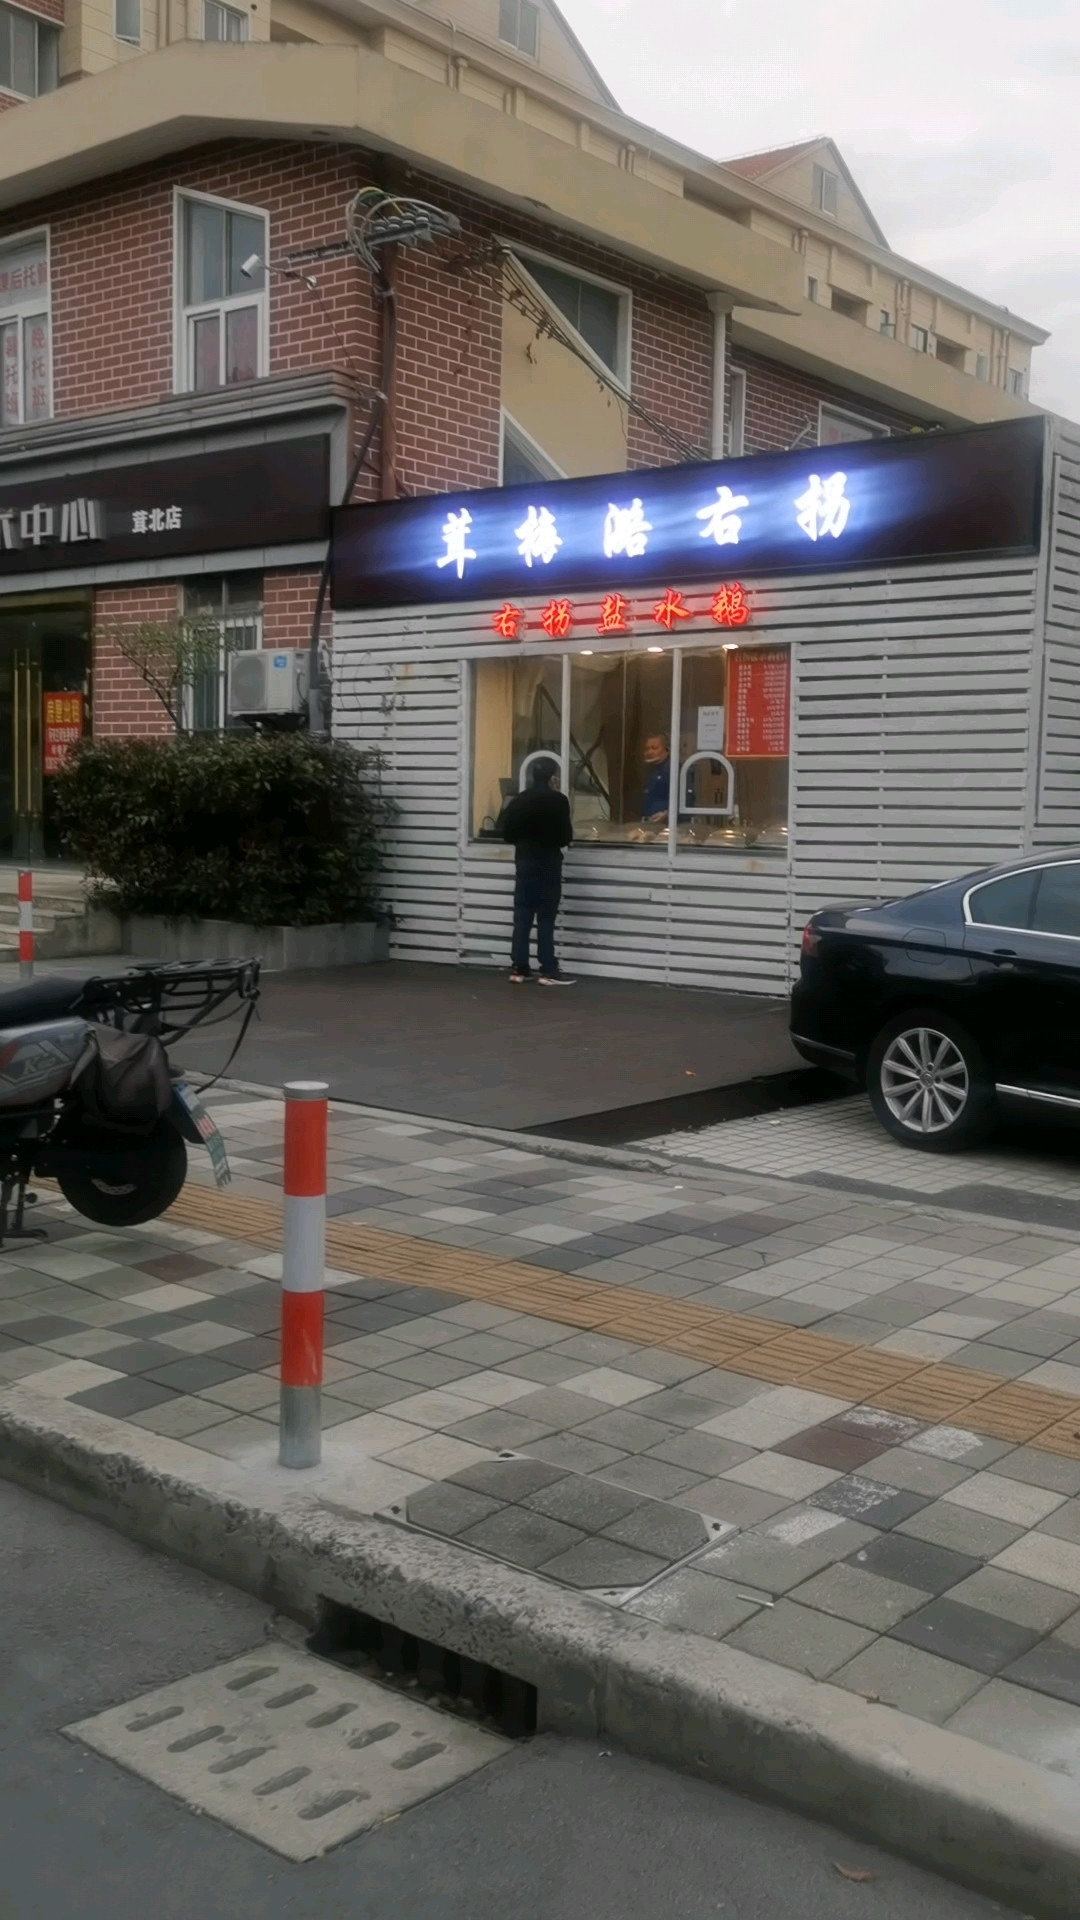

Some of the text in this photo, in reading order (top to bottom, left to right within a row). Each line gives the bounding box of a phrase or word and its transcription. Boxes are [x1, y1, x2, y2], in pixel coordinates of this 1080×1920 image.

[131, 505, 182, 534] 茸北店
[492, 582, 752, 638] 右拐盐水鹅
